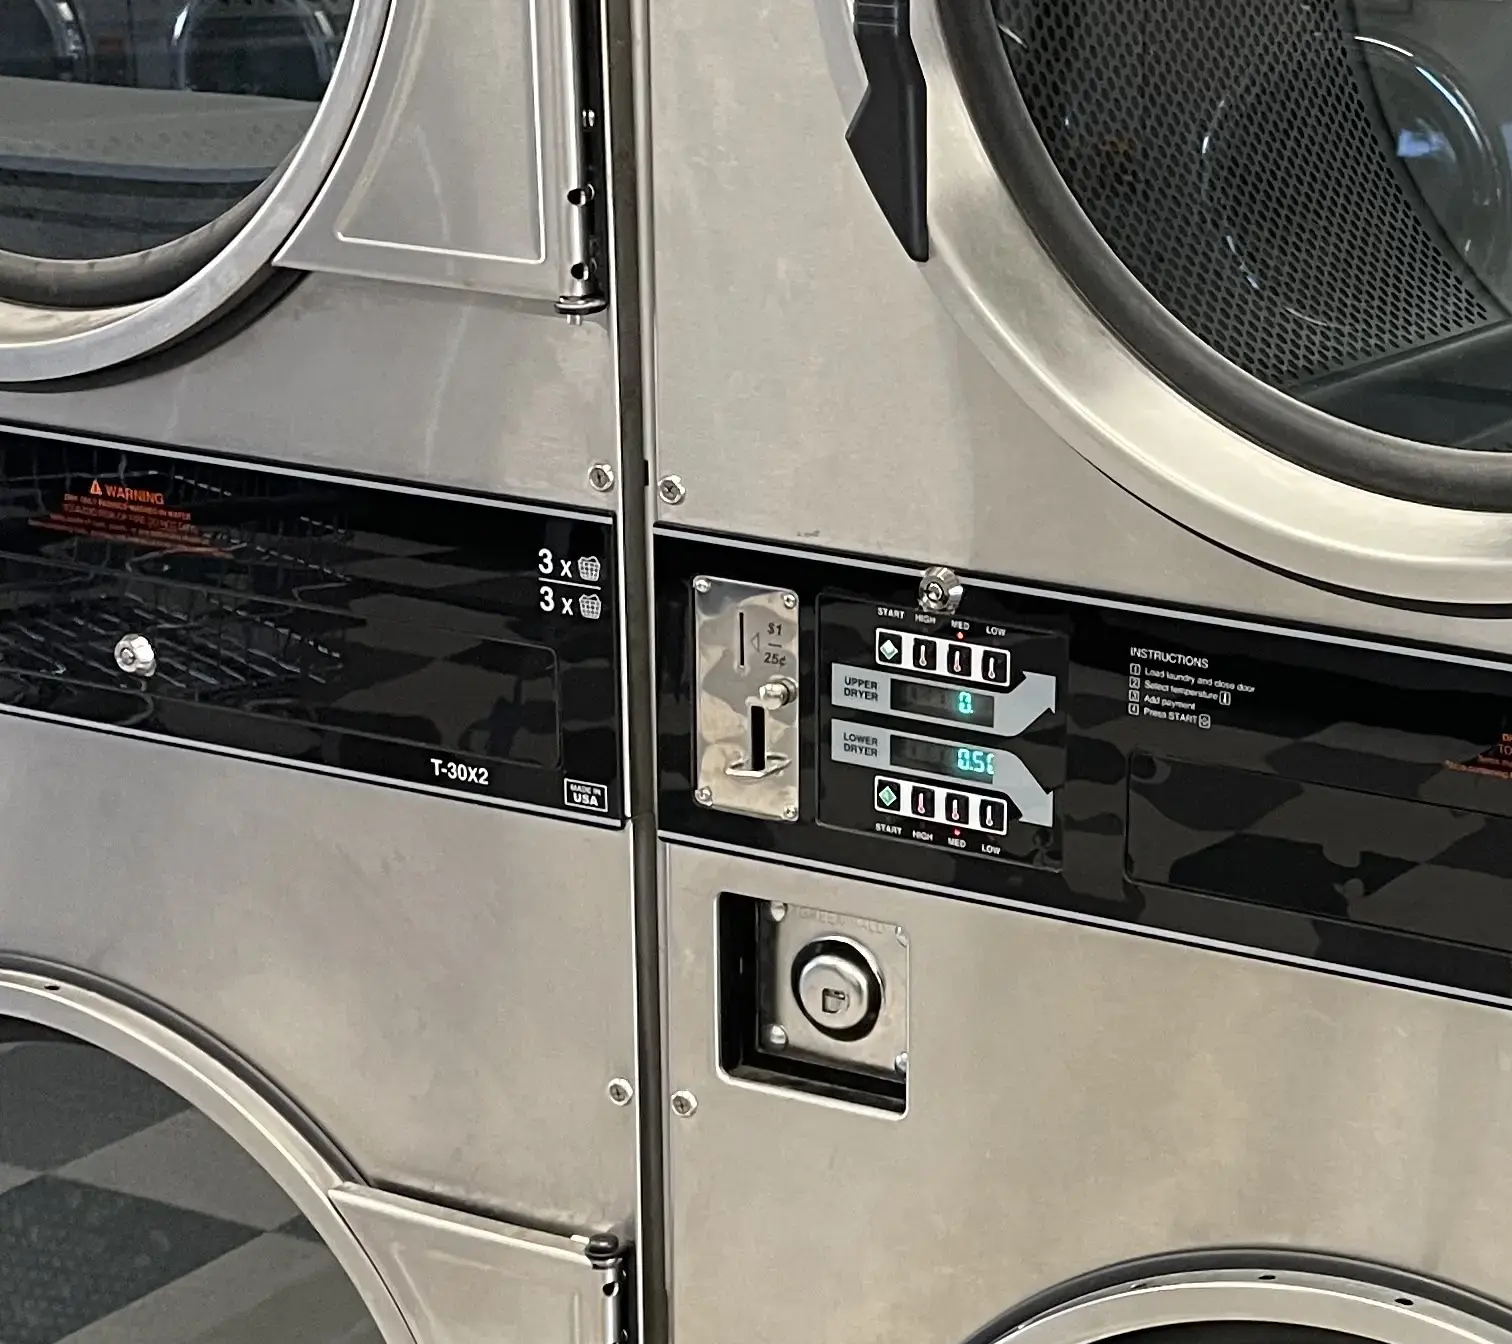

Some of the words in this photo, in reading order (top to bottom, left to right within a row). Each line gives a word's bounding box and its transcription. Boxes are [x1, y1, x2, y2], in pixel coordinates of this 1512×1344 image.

[104, 484, 165, 506] WARNING
[538, 548, 553, 575] 3
[539, 585, 555, 612] 3
[767, 621, 783, 637] $1
[877, 607, 905, 620] START
[914, 613, 937, 626] HIGH
[951, 619, 970, 631] MED
[985, 625, 1007, 637] LOW
[764, 651, 787, 668] 25¢
[1130, 646, 1209, 669] INSTRUCTIONS
[844, 675, 878, 691] UPPER
[1144, 667, 1165, 679] Load
[1166, 671, 1195, 685] laundry
[1197, 677, 1213, 686] and
[1214, 679, 1235, 690] close
[1237, 683, 1256, 693] door
[843, 687, 878, 703] DRYER
[1144, 679, 1169, 692] Select
[1170, 685, 1219, 701] temperature
[1143, 694, 1160, 705] Add
[1161, 698, 1196, 711] payment
[1143, 707, 1167, 719] Press
[1168, 712, 1198, 724] START
[843, 731, 878, 747] LOWER
[843, 742, 878, 758] DRYER
[1498, 743, 1512, 756] TO
[430, 757, 489, 785] T-30X2
[572, 791, 599, 807] USA
[875, 822, 903, 836] START
[912, 829, 934, 842] HIGH
[947, 836, 967, 849] MED
[981, 843, 1001, 855] LOW
